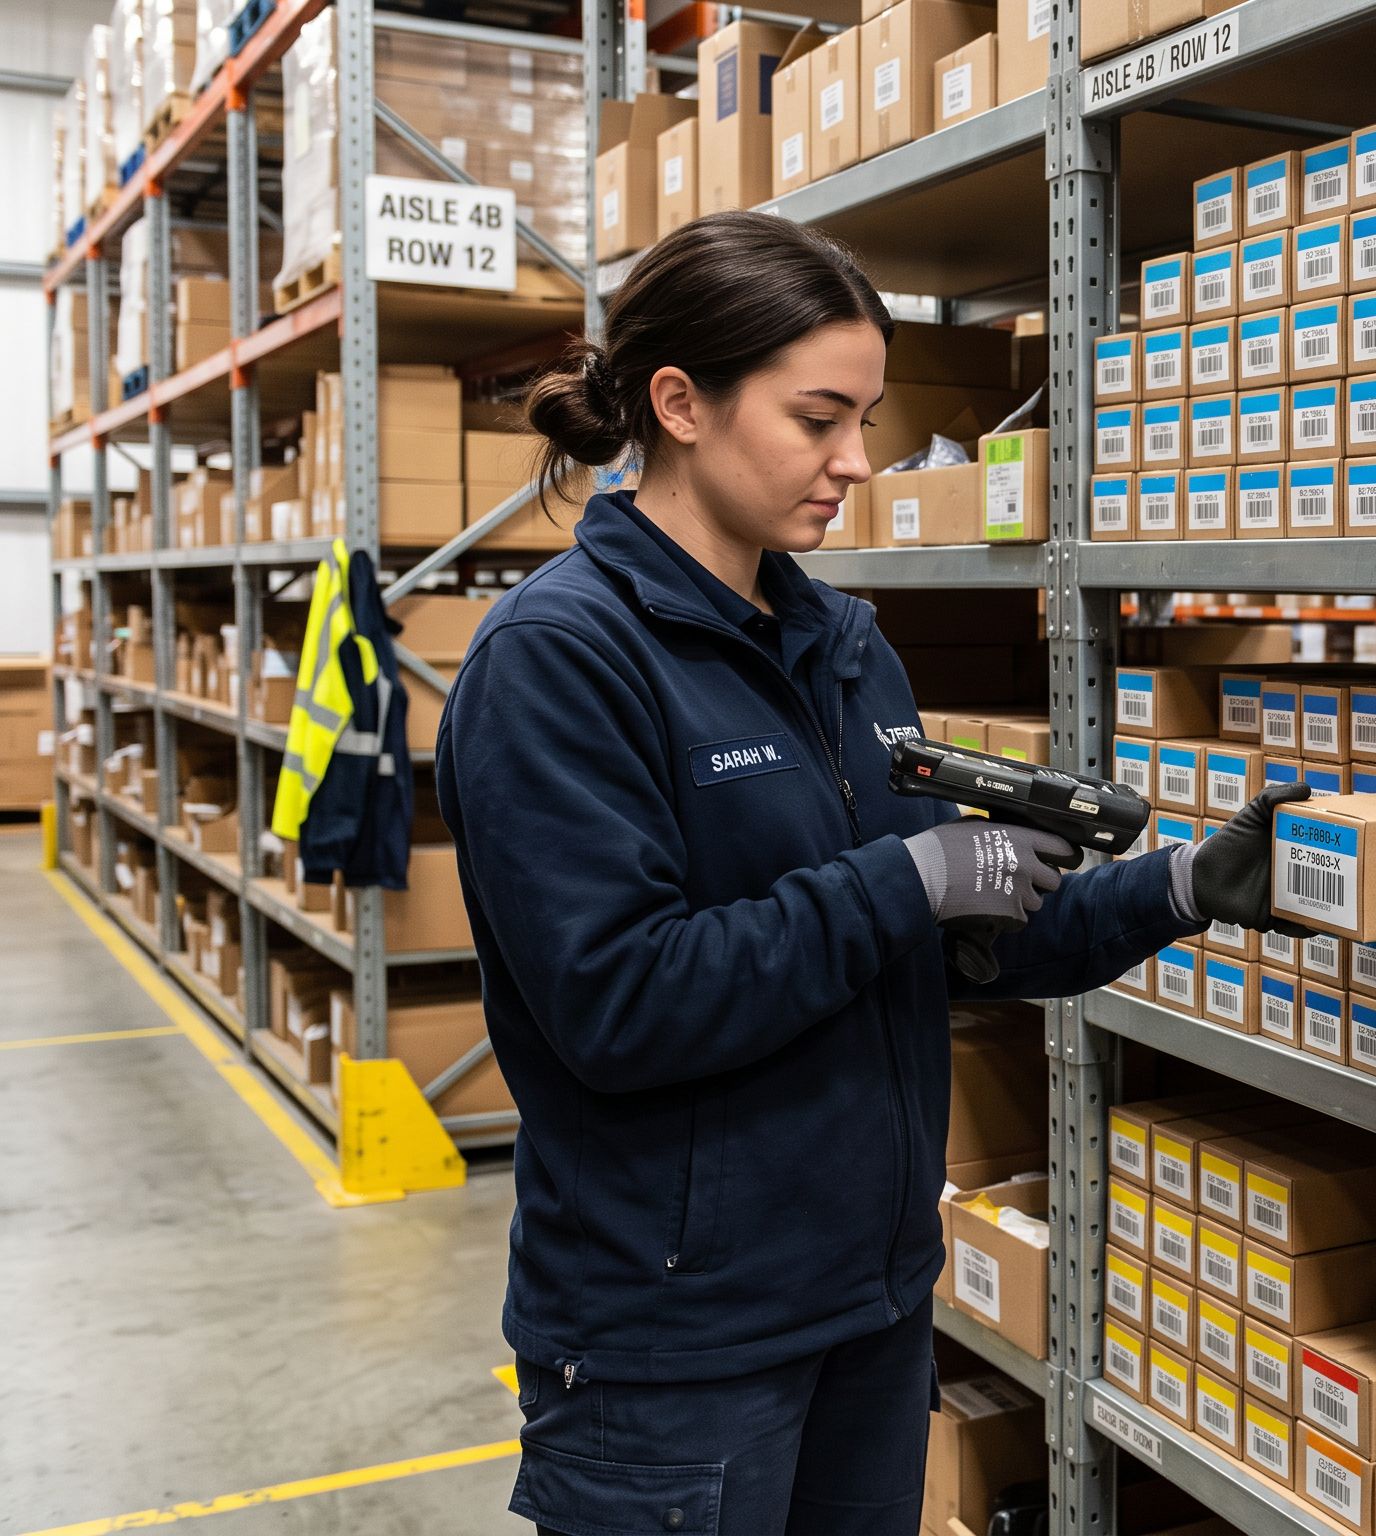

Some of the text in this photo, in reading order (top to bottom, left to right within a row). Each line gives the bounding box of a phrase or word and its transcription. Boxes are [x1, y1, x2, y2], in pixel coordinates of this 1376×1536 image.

[1092, 24, 1231, 102] AISLE 4B / ROW 12
[380, 193, 501, 228] AISLE 4B
[388, 238, 496, 272] ROW 12
[711, 744, 782, 772] SARAH W.
